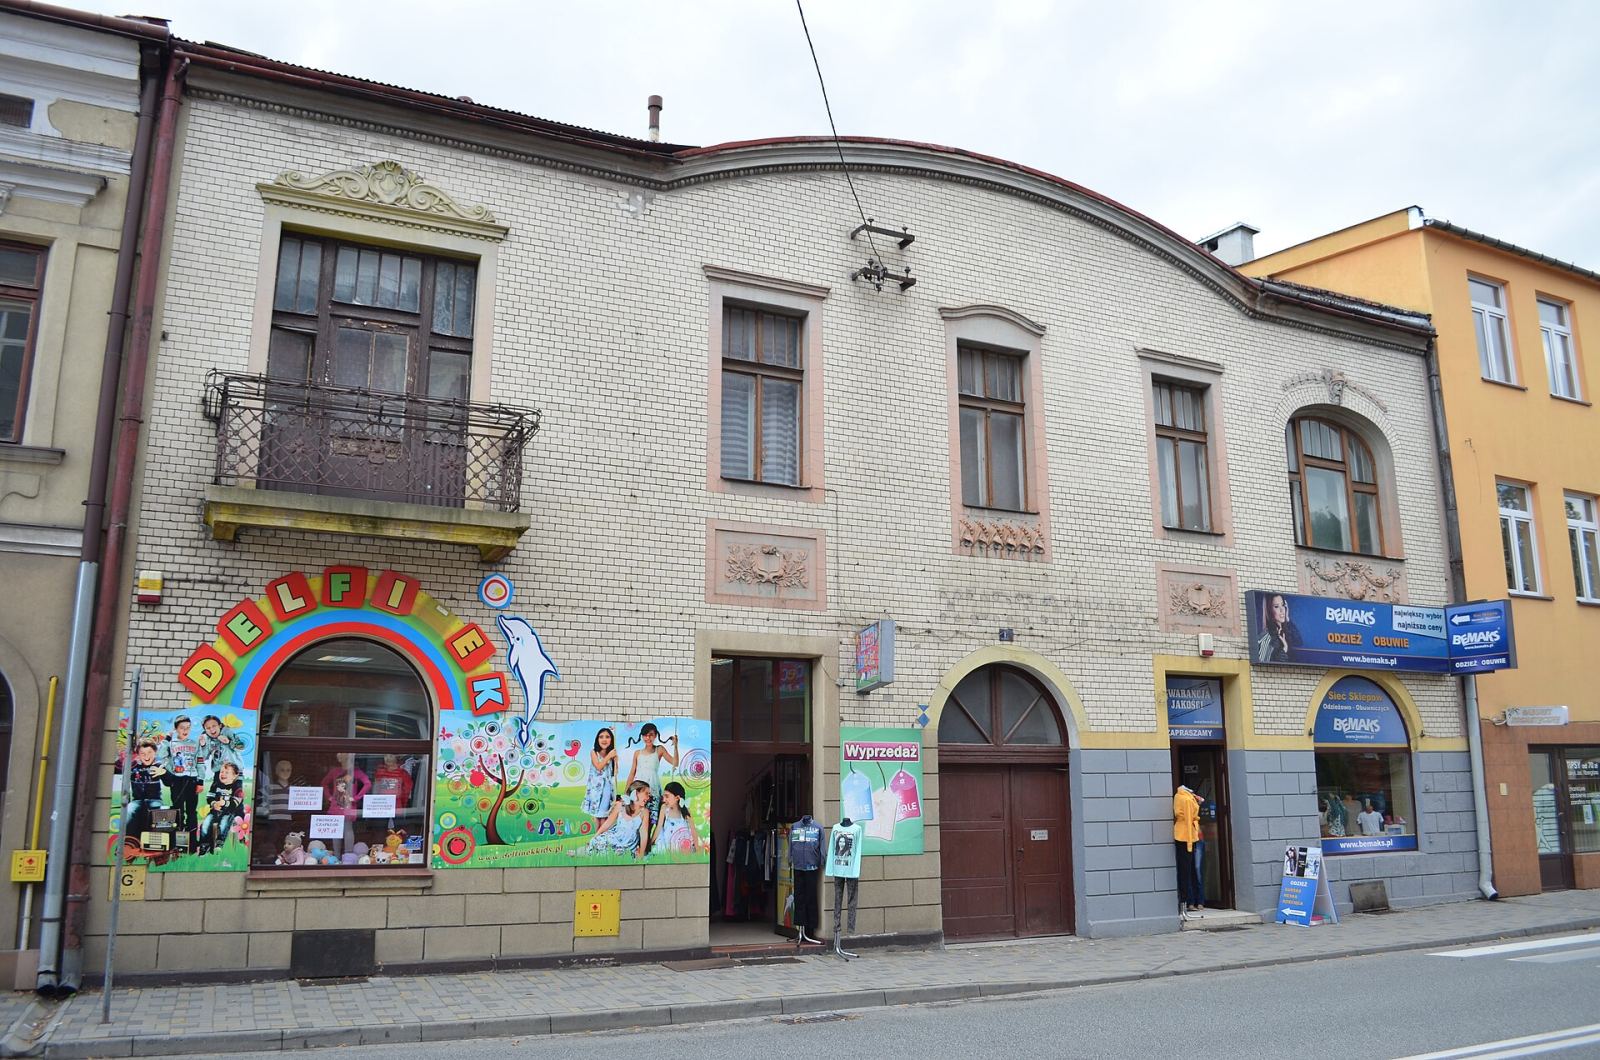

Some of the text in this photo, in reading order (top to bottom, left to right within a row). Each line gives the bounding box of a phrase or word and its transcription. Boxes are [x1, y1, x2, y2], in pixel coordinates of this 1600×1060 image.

[1325, 606, 1376, 626] BEMAKS
[1428, 624, 1443, 632] ceny
[1327, 632, 1409, 648] ODZIEŻ OBUWIE
[1452, 630, 1500, 647] BEMAKS
[1342, 655, 1397, 666] www.bemaks.pl
[1168, 688, 1211, 699] WARANCJA
[1333, 717, 1380, 732] BEMAKS
[845, 744, 917, 760] Wyprzedaż
[1339, 838, 1393, 849] www.bemaks.pl
[121, 873, 133, 887] G
